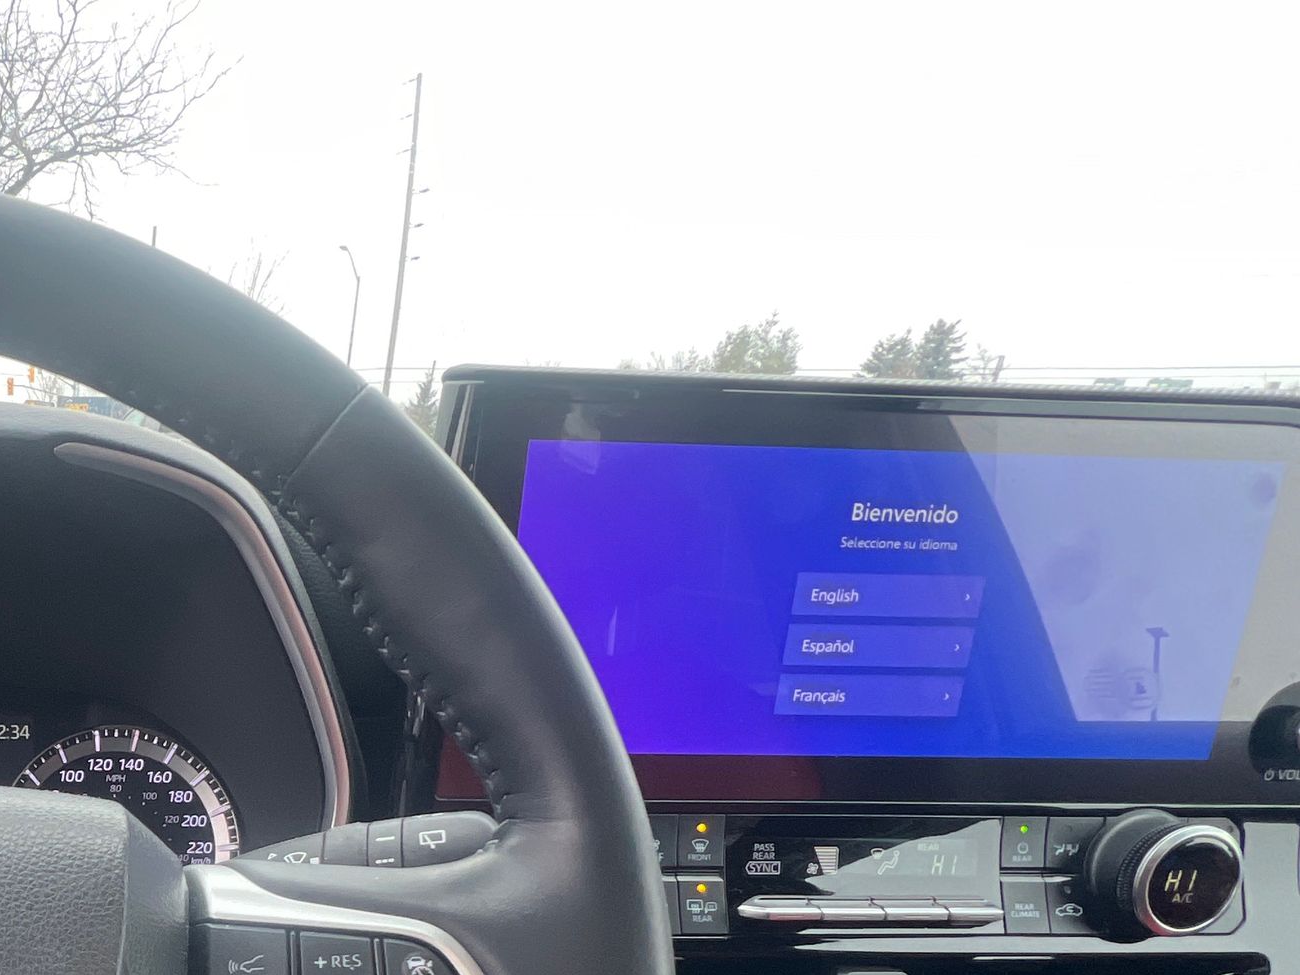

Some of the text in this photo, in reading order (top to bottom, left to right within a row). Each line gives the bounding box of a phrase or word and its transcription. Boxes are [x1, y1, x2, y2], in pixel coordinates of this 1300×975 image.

[851, 502, 959, 524] Bienvenido
[840, 536, 958, 550] Seleccione su idioma
[810, 588, 860, 605] English
[801, 639, 854, 655] Español
[792, 688, 846, 704] Français
[87, 758, 113, 771] 120
[119, 758, 144, 771] 140
[59, 770, 84, 783] 100
[105, 774, 126, 783] MPH
[146, 771, 173, 784] 160
[110, 784, 122, 793] 80
[142, 792, 157, 800] 100
[168, 790, 193, 803] 180
[164, 815, 180, 824] 120
[181, 815, 207, 828] 200
[186, 841, 213, 854] 220
[753, 843, 775, 851] PASS
[917, 843, 940, 851] REAR
[688, 853, 712, 861] FRONT
[752, 852, 776, 860] REAR
[748, 862, 778, 874] SYNC
[1164, 869, 1198, 892] HI
[1172, 892, 1193, 903] A/C
[692, 915, 713, 923] REAR
[1011, 910, 1040, 918] CLIMATE
